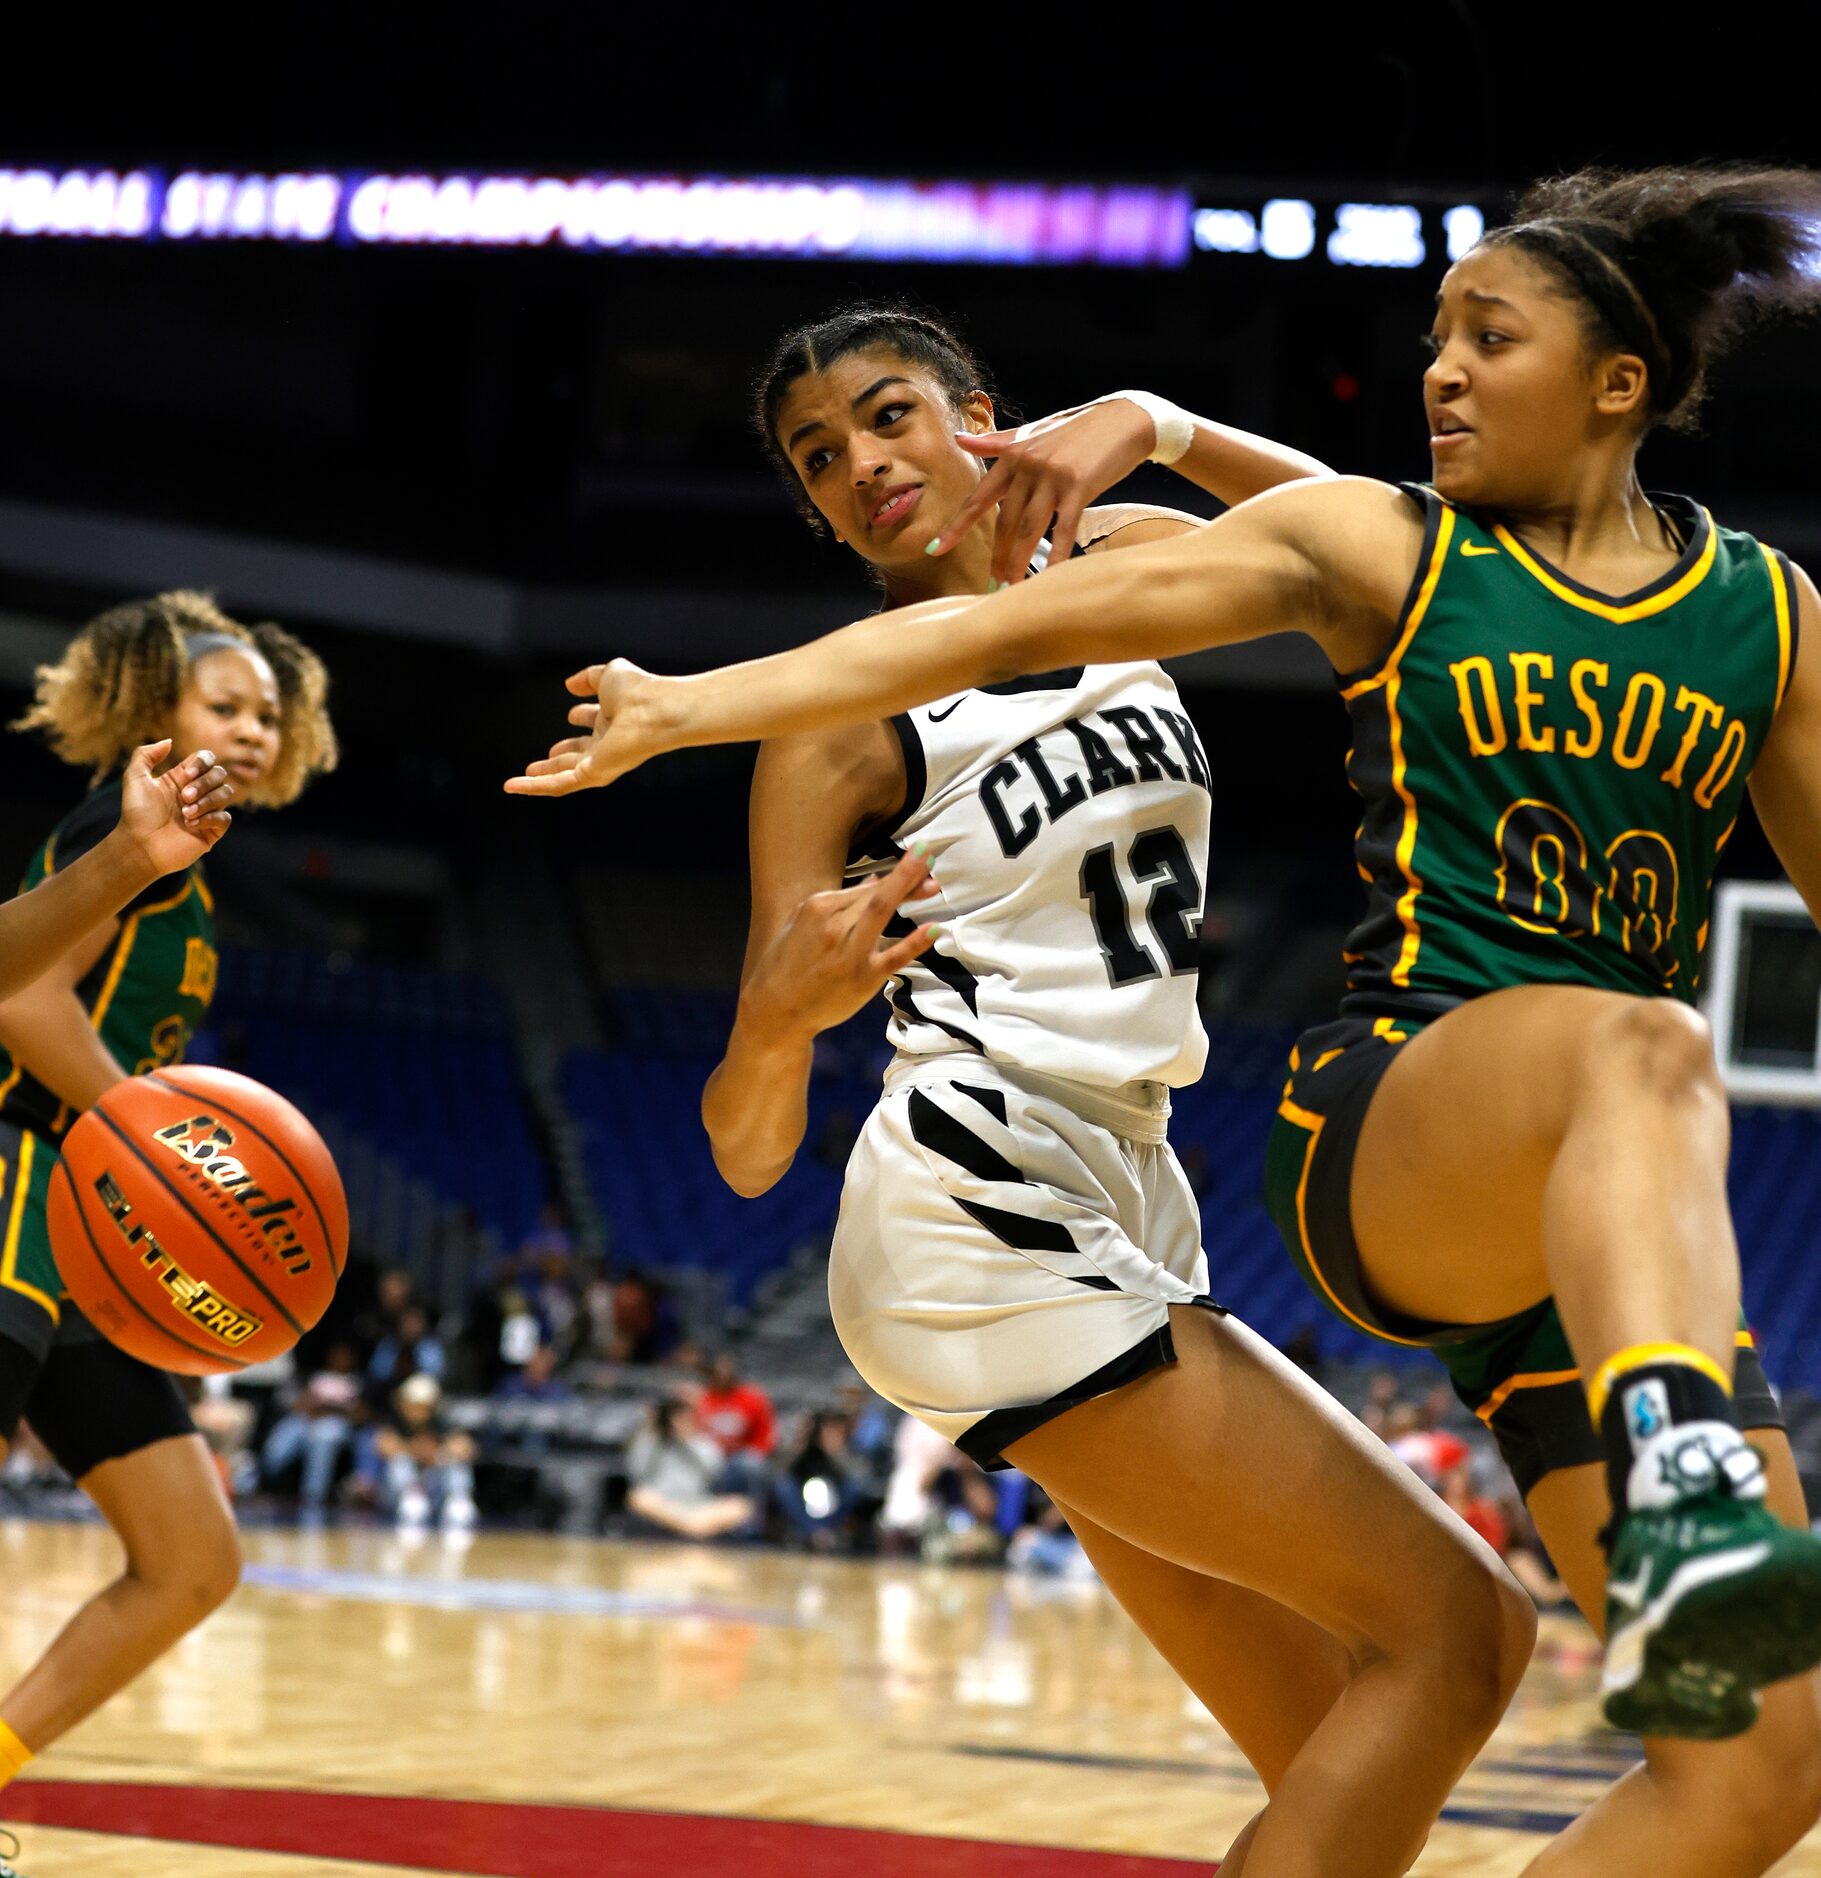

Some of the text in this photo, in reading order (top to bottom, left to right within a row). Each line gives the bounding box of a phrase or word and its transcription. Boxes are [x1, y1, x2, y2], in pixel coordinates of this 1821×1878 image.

[978, 704, 1212, 859] CLARK
[1449, 651, 1746, 809] DESOTO
[1079, 824, 1203, 989] 12
[153, 1115, 312, 1278] Baden
